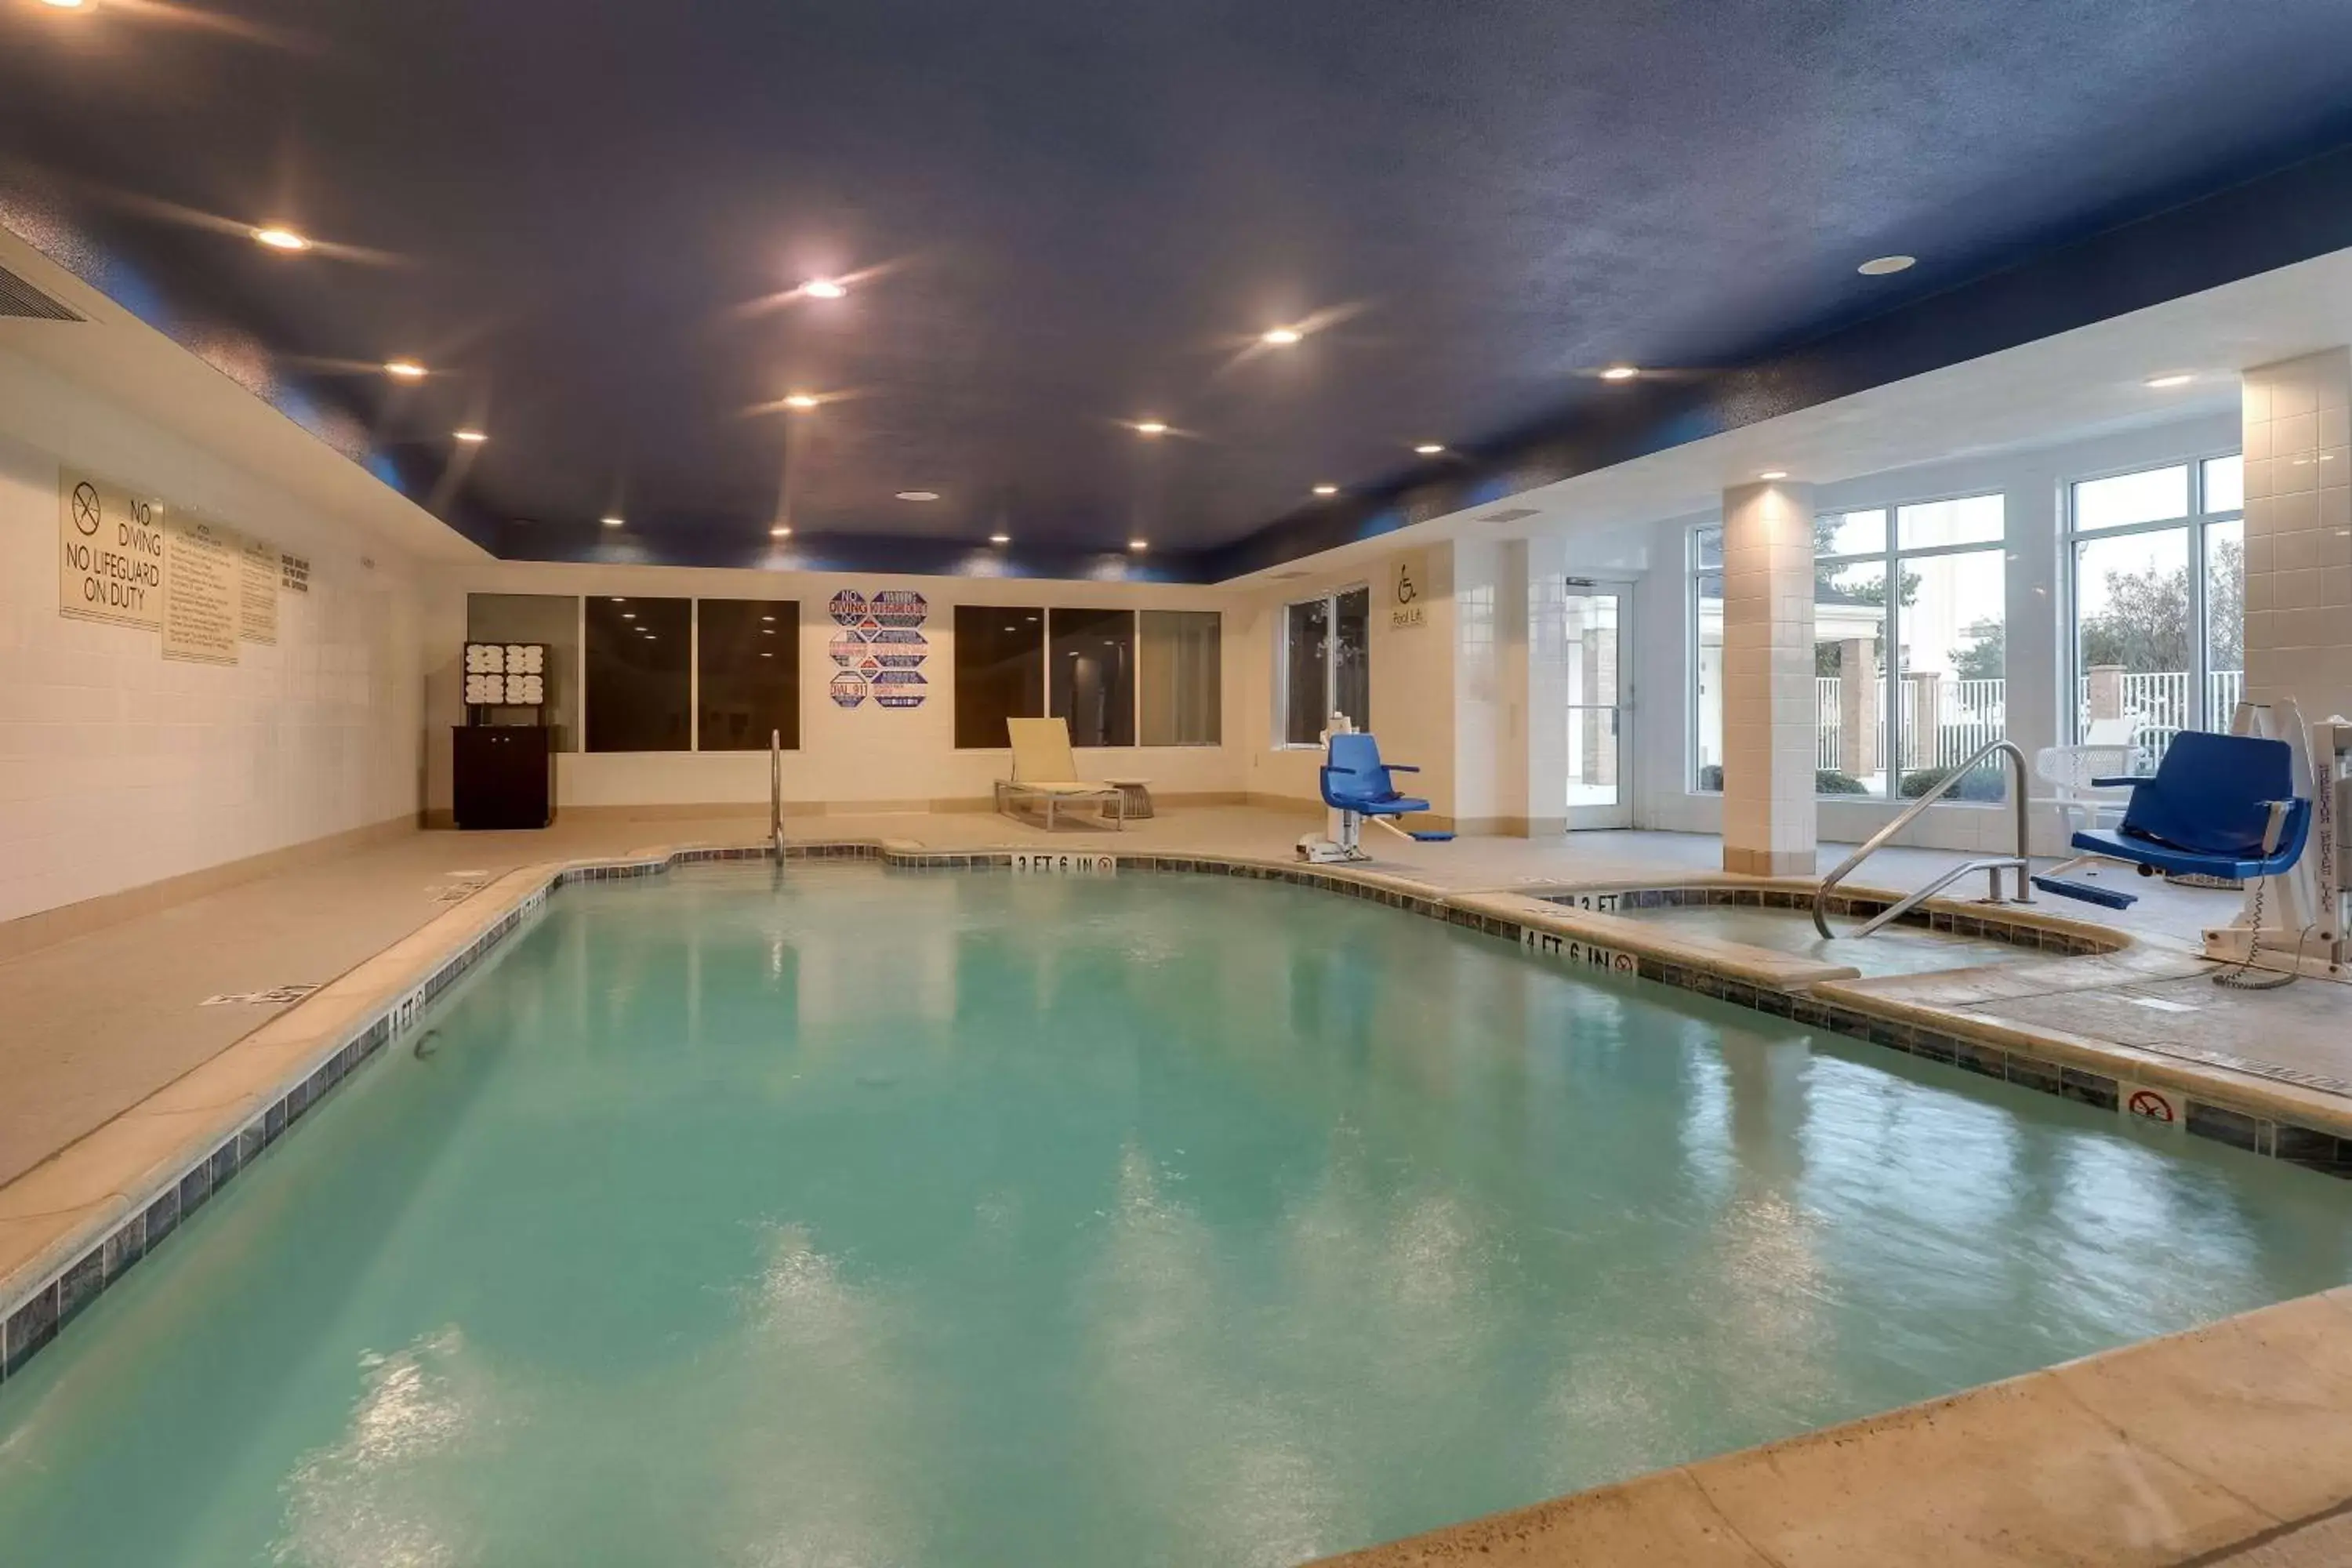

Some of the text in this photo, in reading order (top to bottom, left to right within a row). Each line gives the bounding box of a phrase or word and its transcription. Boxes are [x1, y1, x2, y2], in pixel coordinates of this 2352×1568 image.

[131, 499, 151, 526] NO
[118, 523, 161, 557] DIVING
[67, 542, 90, 571] NO
[93, 549, 159, 587] LIFEGUARD
[84, 577, 145, 611] ON DUTY
[829, 601, 867, 613] DIVING
[841, 590, 858, 601] NO
[830, 684, 850, 695] DIAL
[1033, 855, 1052, 868] FT
[1076, 857, 1093, 871] IN
[1598, 895, 1618, 911] FT
[1541, 934, 1563, 953] FT
[1588, 946, 1610, 967] IN
